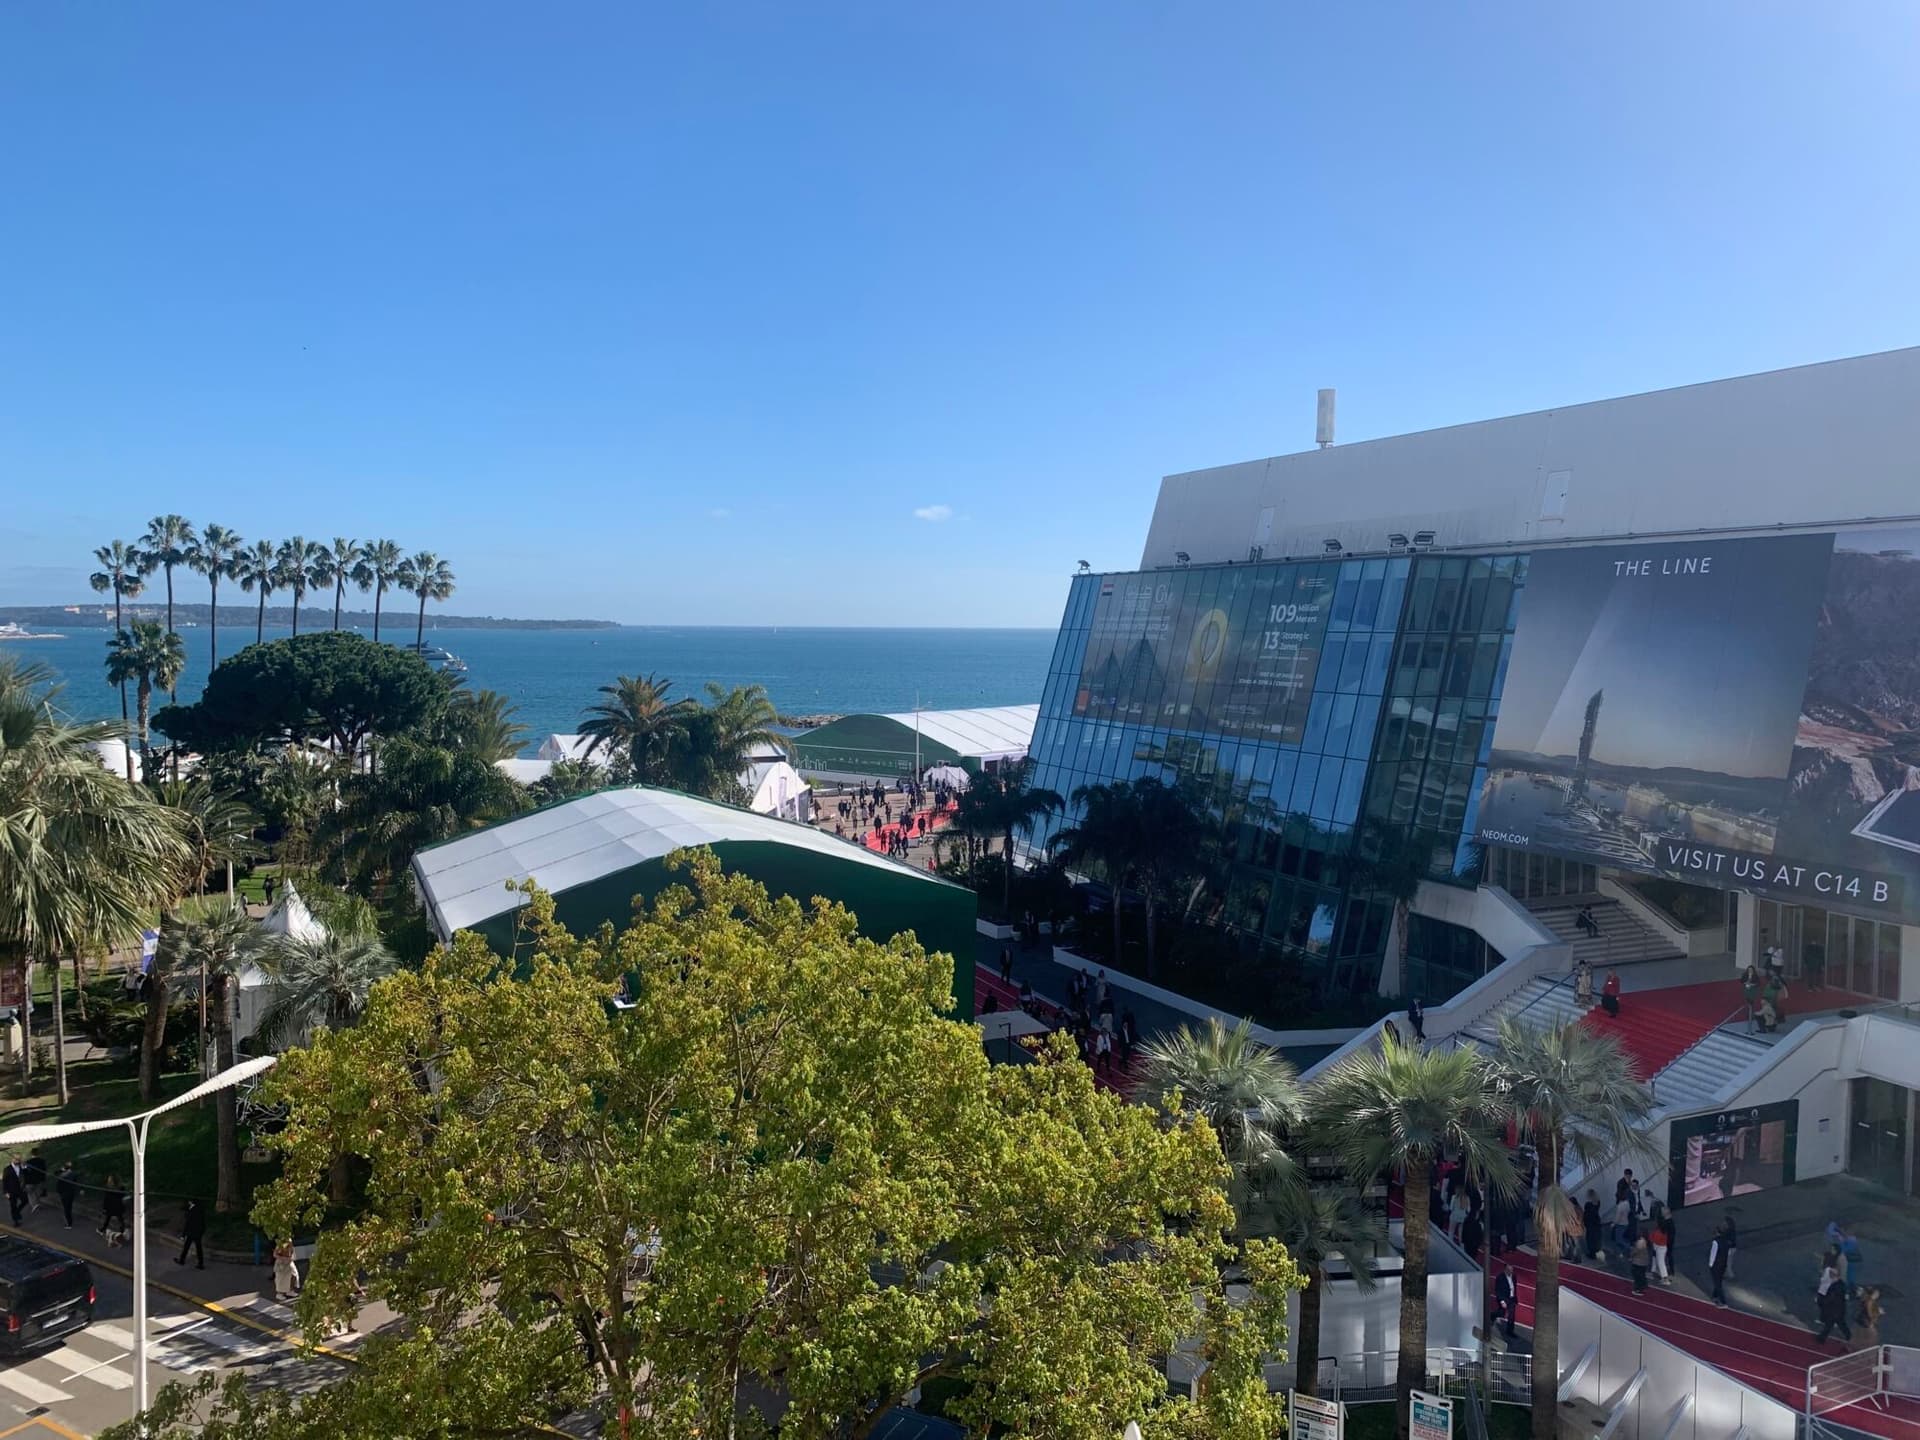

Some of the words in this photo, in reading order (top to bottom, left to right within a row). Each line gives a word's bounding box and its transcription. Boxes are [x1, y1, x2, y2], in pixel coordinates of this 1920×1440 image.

[1614, 560, 1651, 576] THE
[1662, 557, 1712, 575] LINE
[1270, 604, 1297, 623] 109
[1264, 631, 1280, 649] 13
[1481, 829, 1529, 846] NEOM.COM
[1667, 846, 1726, 873] VISIT
[1733, 856, 1765, 881] US
[1772, 865, 1806, 887] AT
[1814, 872, 1861, 898] C14
[1872, 881, 1889, 902] B
